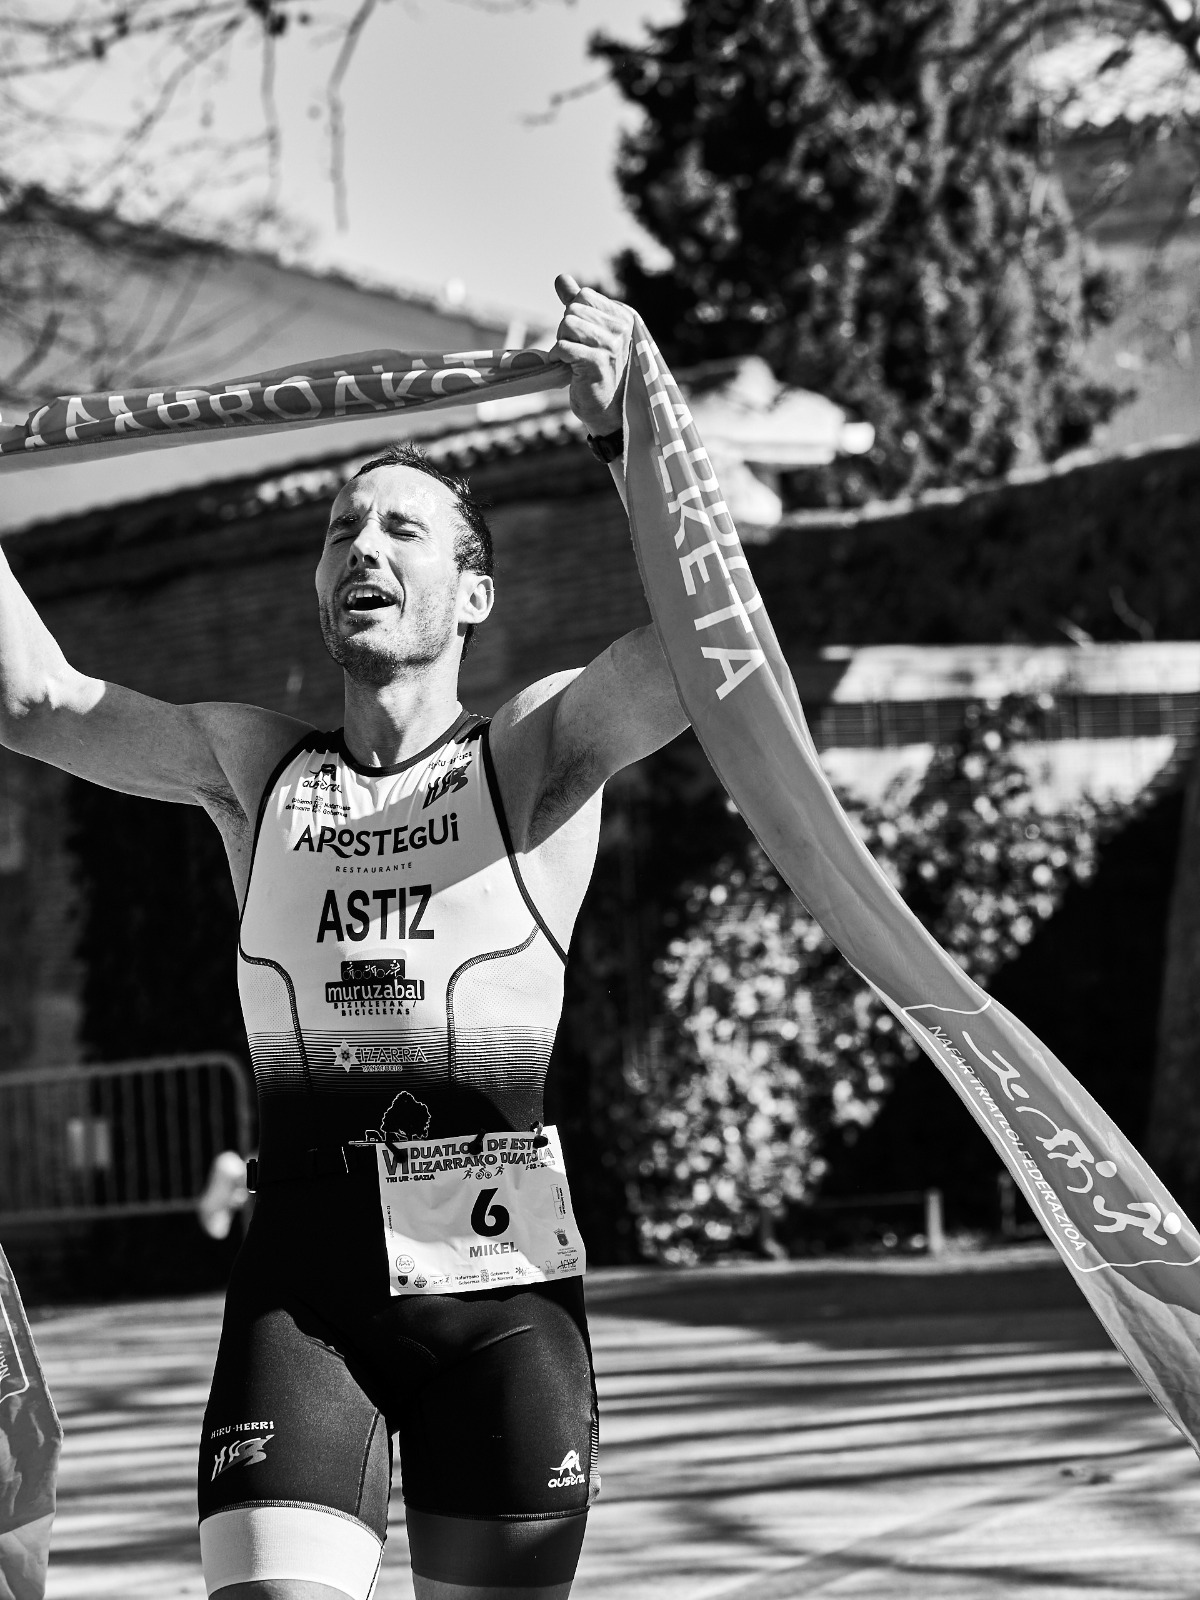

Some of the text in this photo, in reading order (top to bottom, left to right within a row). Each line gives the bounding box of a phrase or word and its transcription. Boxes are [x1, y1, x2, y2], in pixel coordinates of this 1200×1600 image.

[335, 862, 413, 873] RESTAURANTE
[316, 884, 435, 943] ASTIZ
[328, 979, 421, 1001] muruzabal
[333, 1001, 404, 1009] BIZIKLETAK
[341, 1008, 410, 1016] BICICLETAS
[360, 1047, 428, 1062] IZARRA
[410, 1140, 484, 1159] DUATLO
[487, 1138, 508, 1152] DE
[928, 1026, 975, 1075] NAFAR
[1017, 1149, 1087, 1252] FEDERAZIOA
[411, 1153, 498, 1174] LIZARRAKO
[470, 1187, 510, 1237] 6
[469, 1241, 519, 1258] MIKEL
